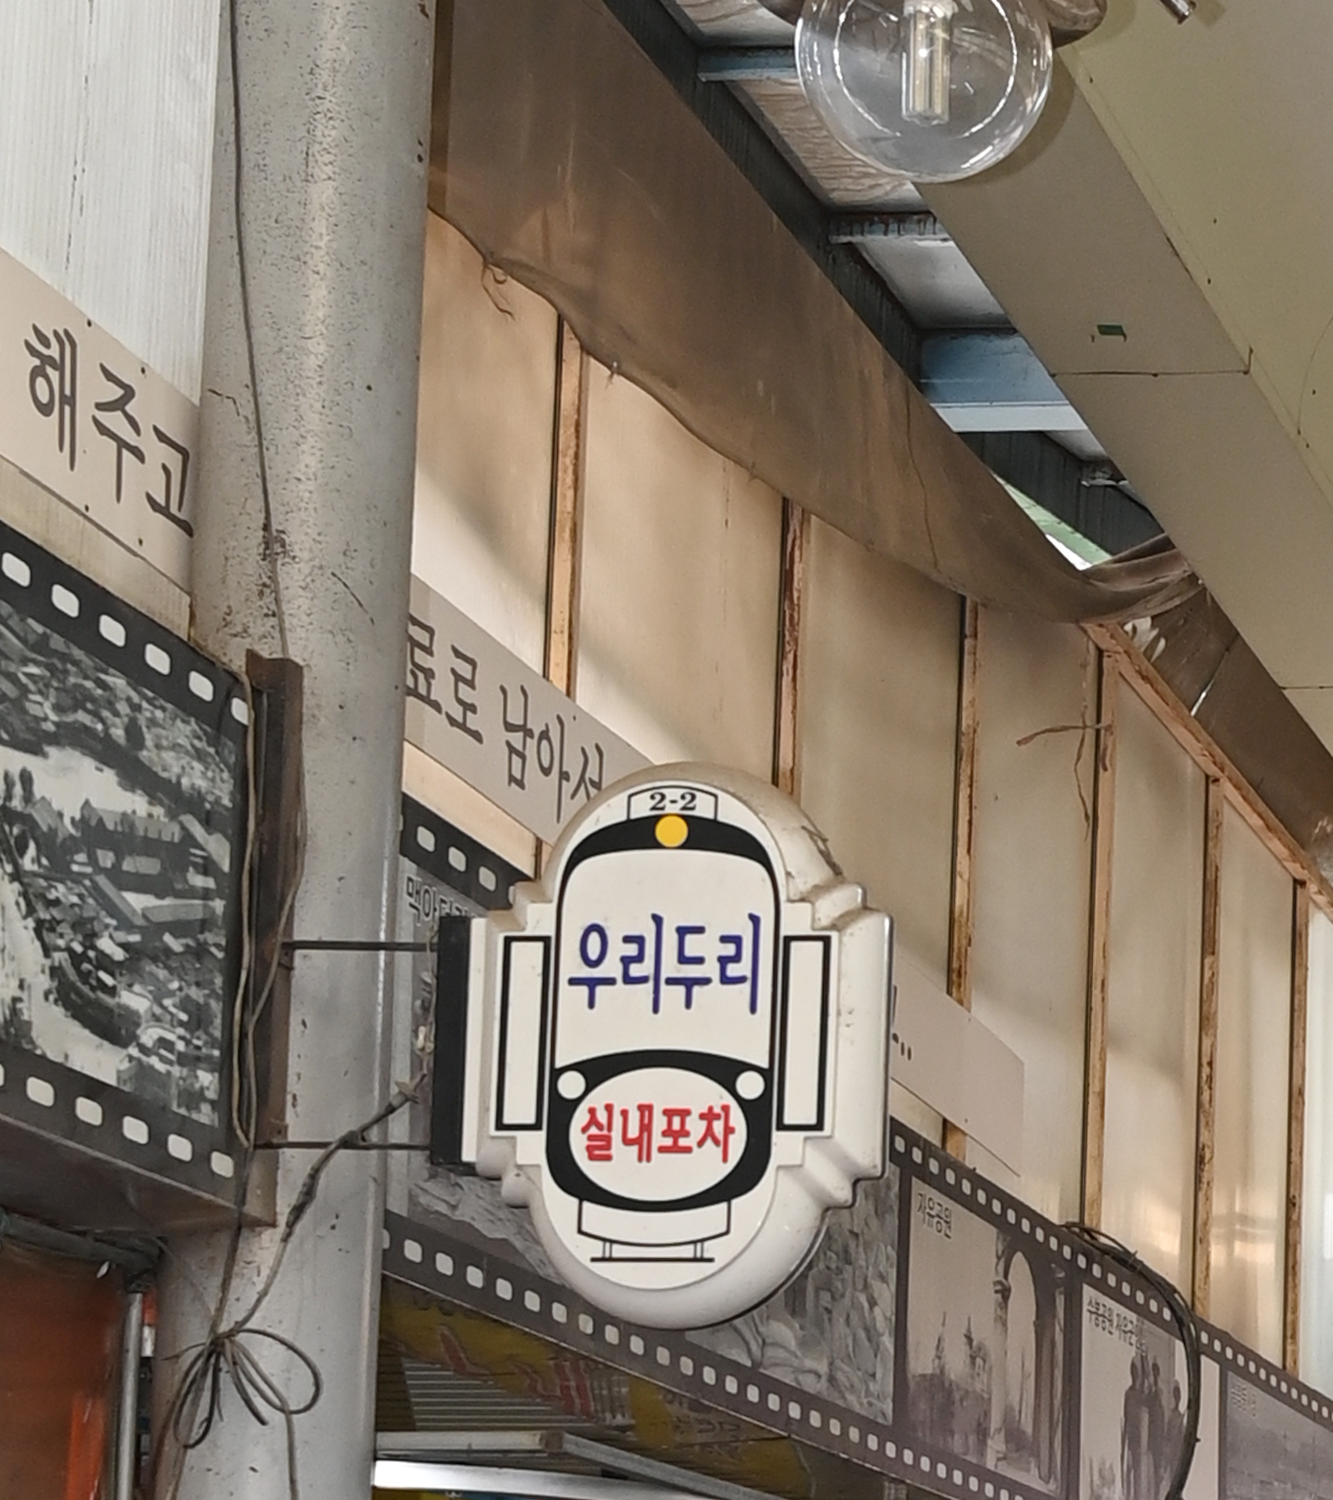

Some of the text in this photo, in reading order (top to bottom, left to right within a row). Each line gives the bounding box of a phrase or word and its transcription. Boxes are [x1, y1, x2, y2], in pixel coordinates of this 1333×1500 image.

[24, 323, 194, 538] 해주고
[648, 791, 698, 813] 2-2
[567, 912, 762, 1016] 우리두리
[580, 1101, 737, 1165] 실내포차
